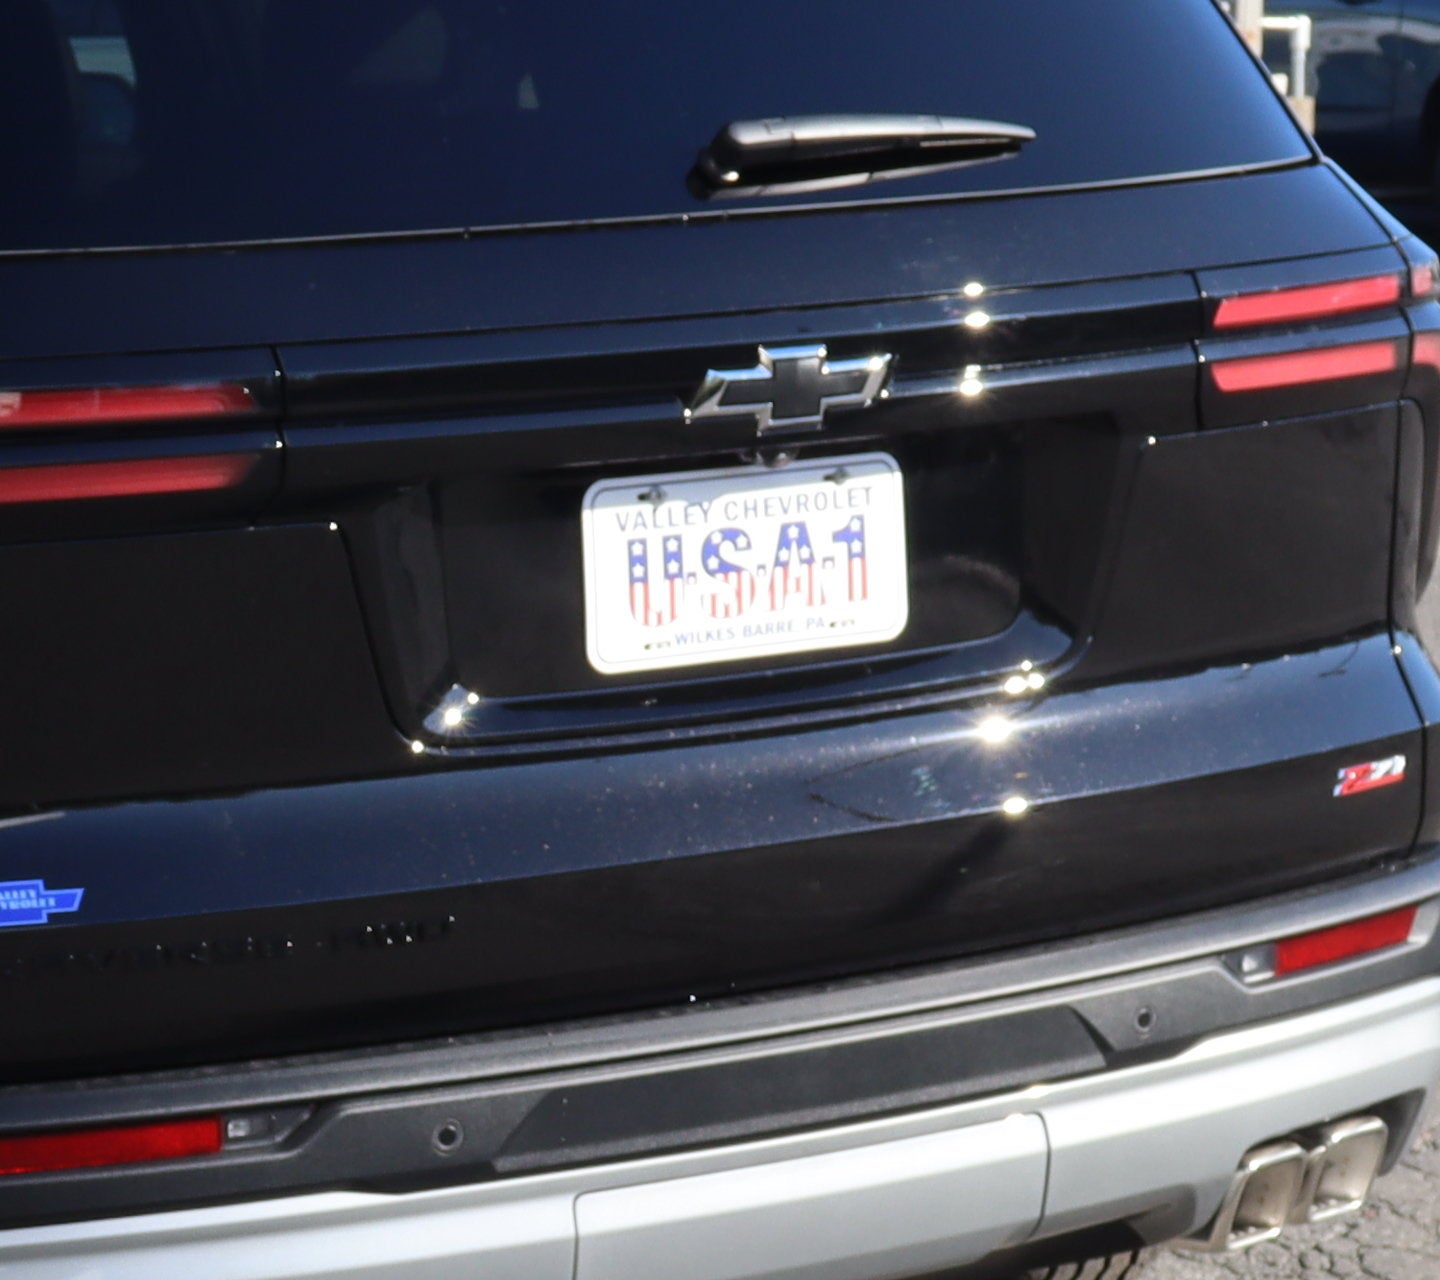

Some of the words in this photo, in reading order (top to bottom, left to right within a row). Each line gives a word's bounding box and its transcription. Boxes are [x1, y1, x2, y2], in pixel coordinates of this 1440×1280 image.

[615, 500, 715, 533] VALLEY
[723, 486, 874, 521] CHEVROLET
[674, 627, 736, 646] WILKES
[742, 620, 795, 638] BARRE
[805, 617, 826, 630] PA
